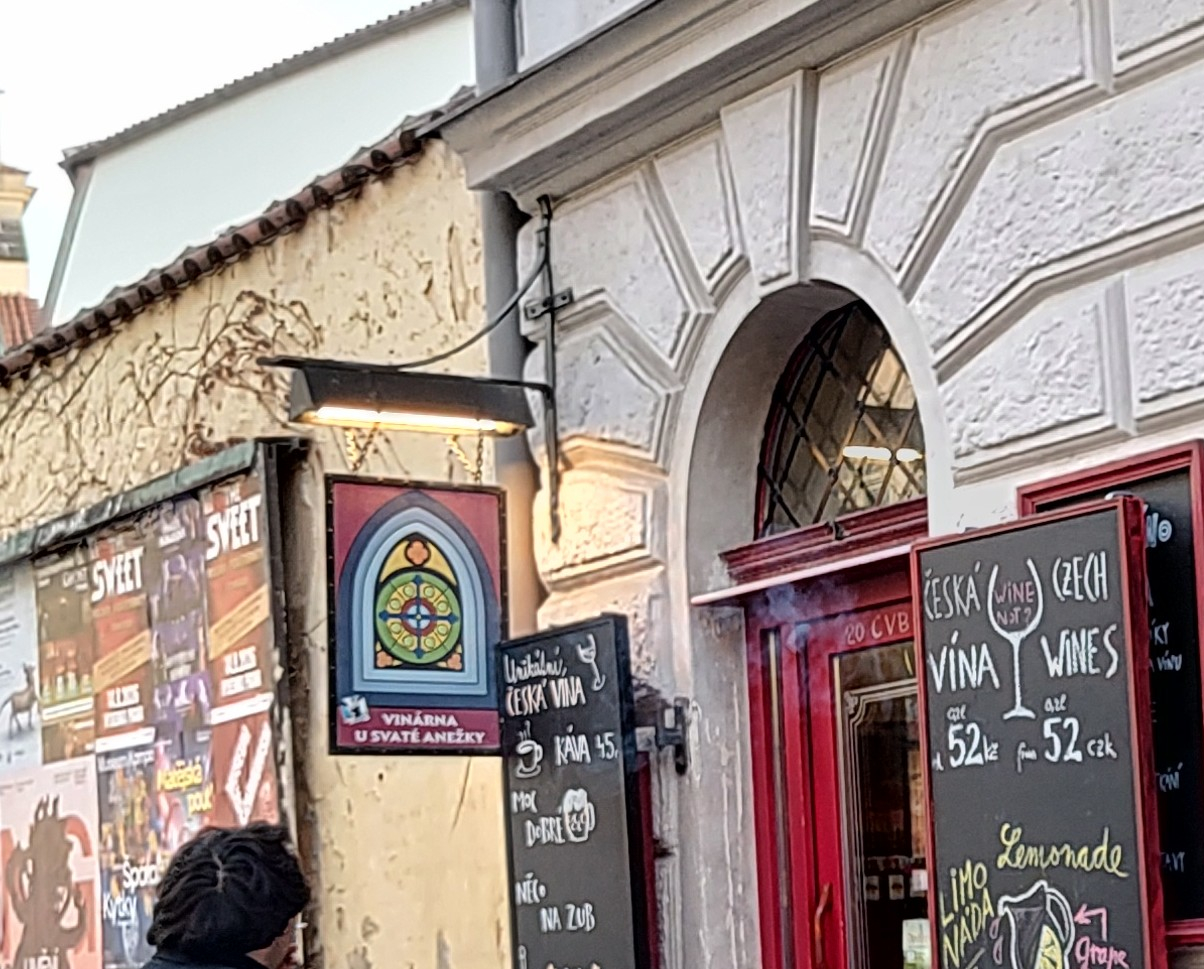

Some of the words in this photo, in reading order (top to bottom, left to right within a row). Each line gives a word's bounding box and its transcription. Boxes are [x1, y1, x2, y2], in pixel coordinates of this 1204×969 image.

[206, 493, 262, 560] SWEET
[91, 547, 144, 602] SWEET
[924, 560, 982, 621] ČESKÁ
[1052, 550, 1109, 602] CZECH
[927, 630, 1000, 694] VÍNA
[1040, 623, 1120, 680] WINES
[381, 710, 459, 727] VINÁRNA
[505, 678, 548, 716] ČESKÁ
[354, 730, 368, 743] U
[370, 728, 420, 743] SVATÉ
[423, 729, 486, 744] ANEŽKY
[554, 724, 592, 766] KÁVA
[1043, 716, 1084, 763] 52
[997, 822, 1130, 878] Lemonade
[540, 906, 562, 933] NA
[564, 902, 596, 932] ZUB
